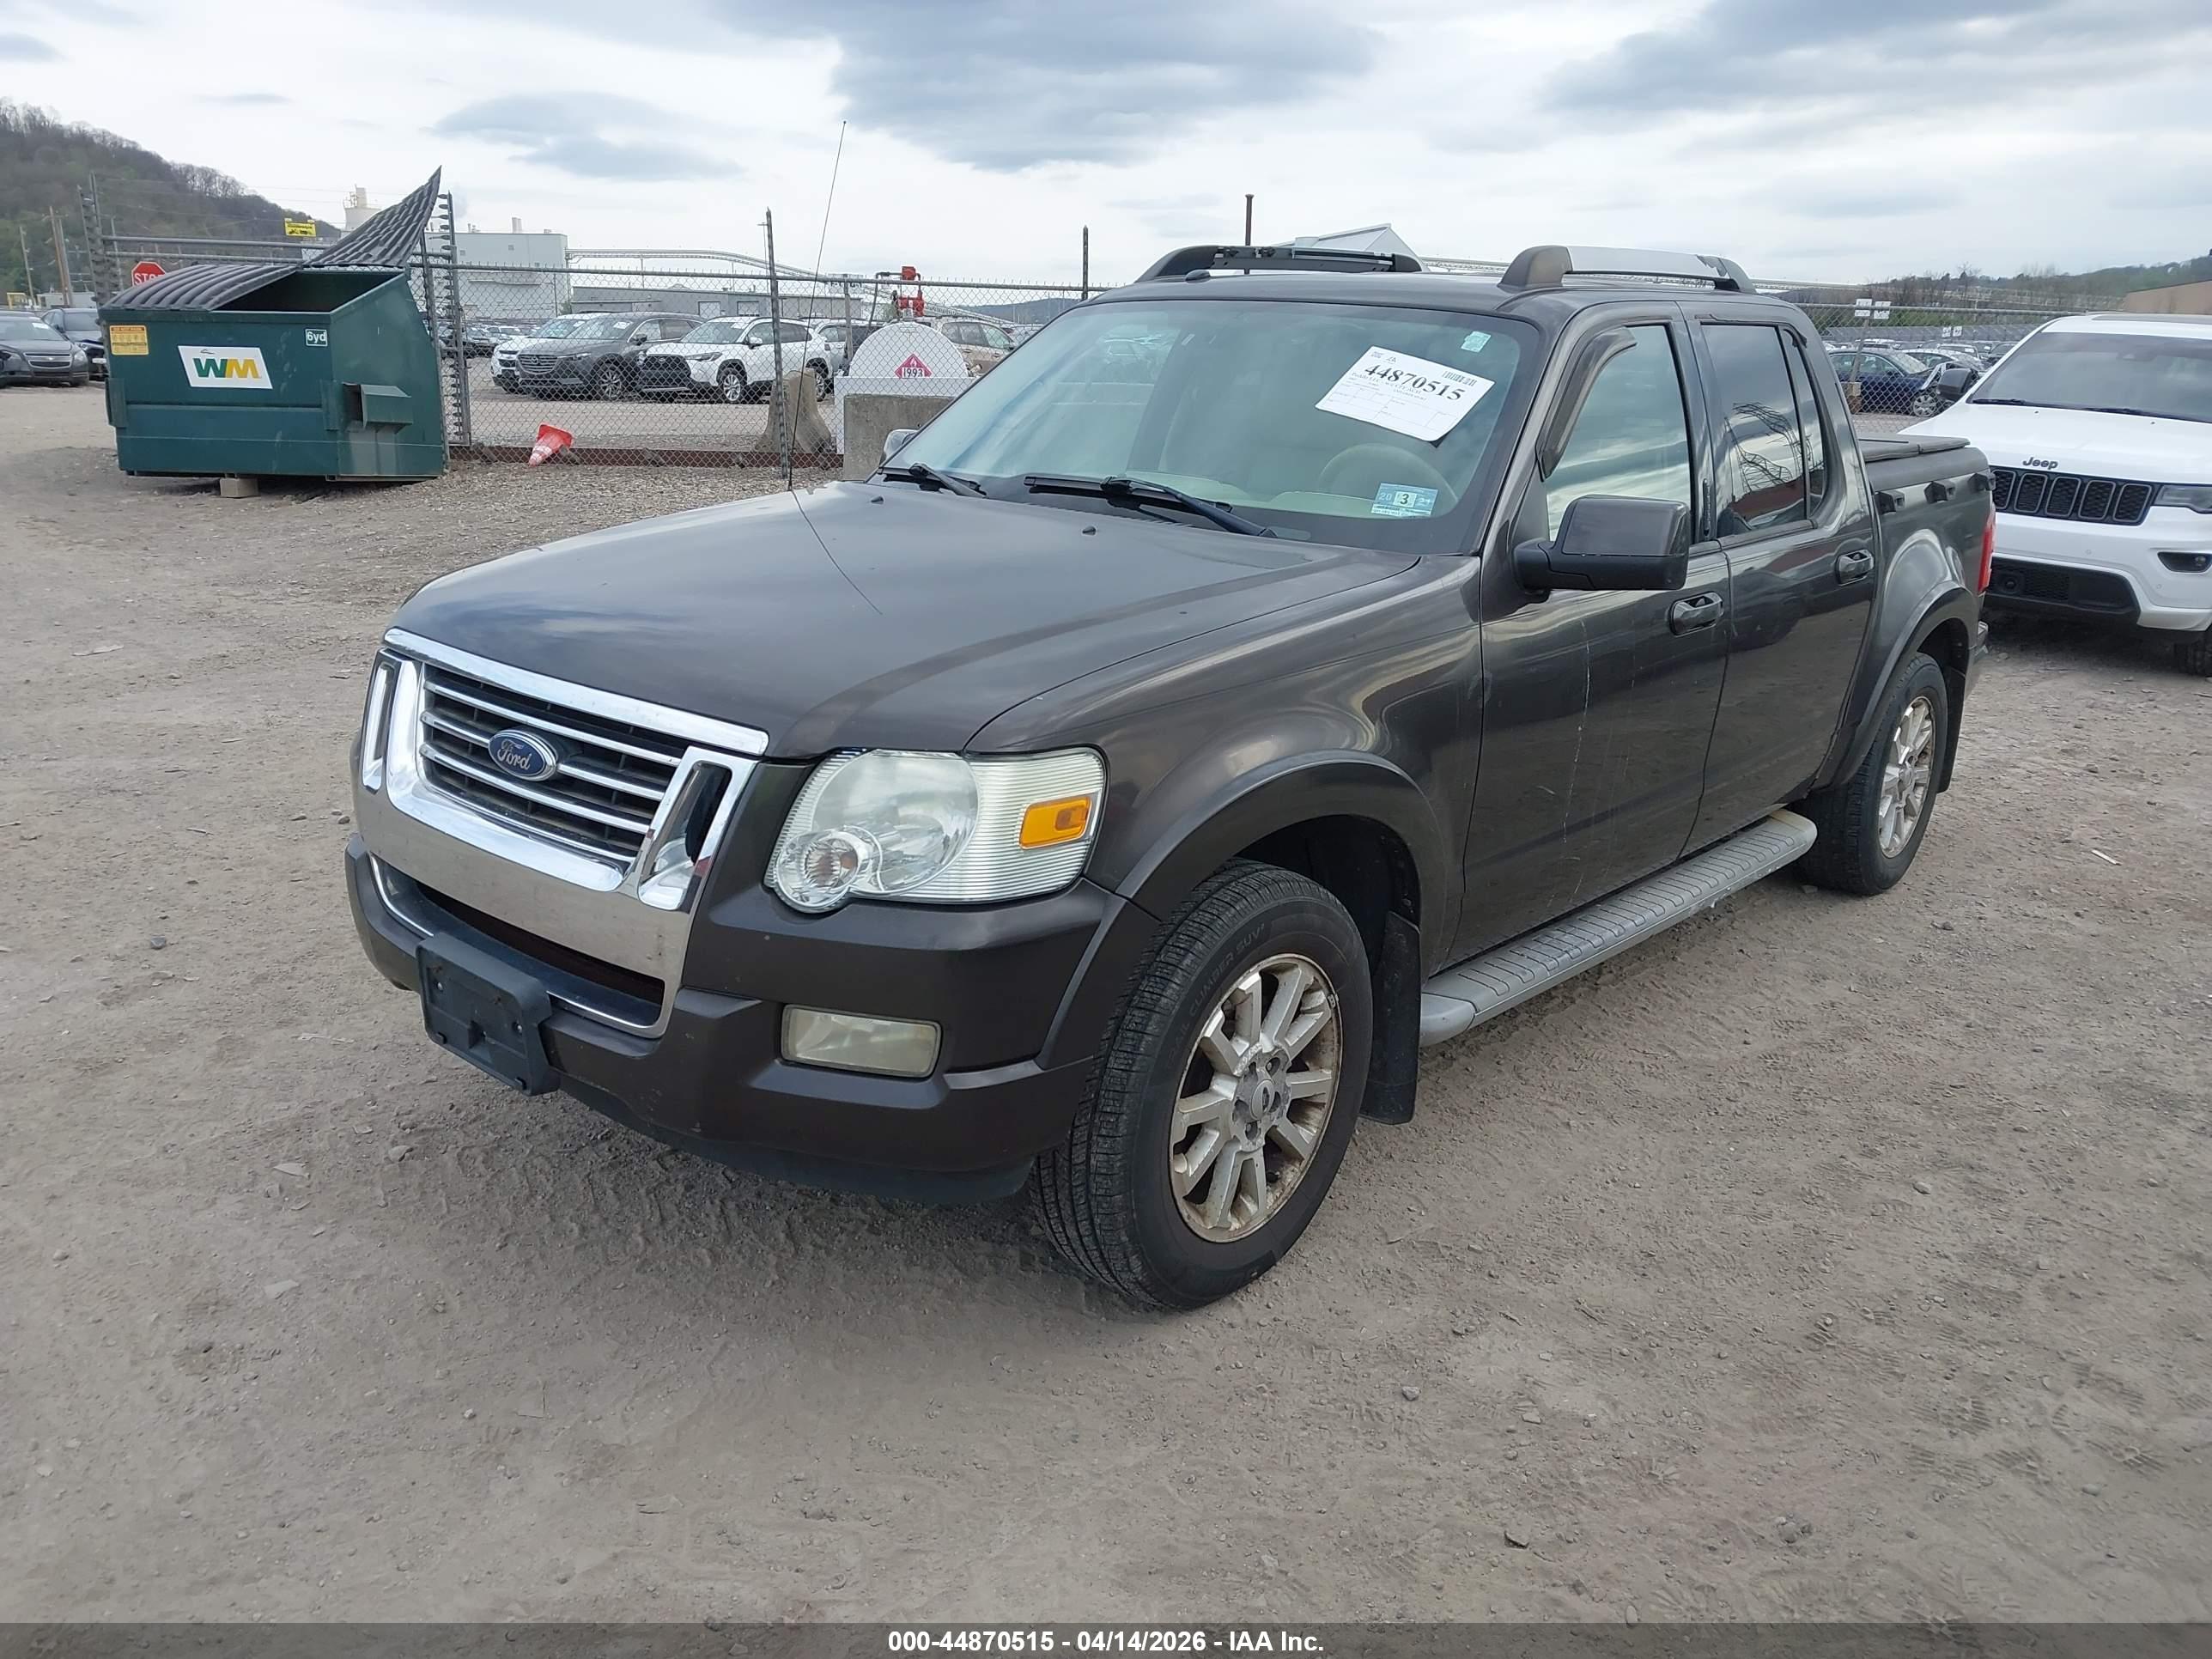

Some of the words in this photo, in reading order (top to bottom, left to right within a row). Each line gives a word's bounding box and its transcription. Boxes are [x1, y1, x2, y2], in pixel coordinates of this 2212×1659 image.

[307, 331, 326, 344] 6yd
[192, 357, 260, 379] WM
[903, 367, 923, 378] 1993
[1364, 364, 1466, 401] 44870515
[2022, 456, 2058, 470] Jeep
[1400, 493, 1410, 505] 3
[496, 738, 532, 770] Ford
